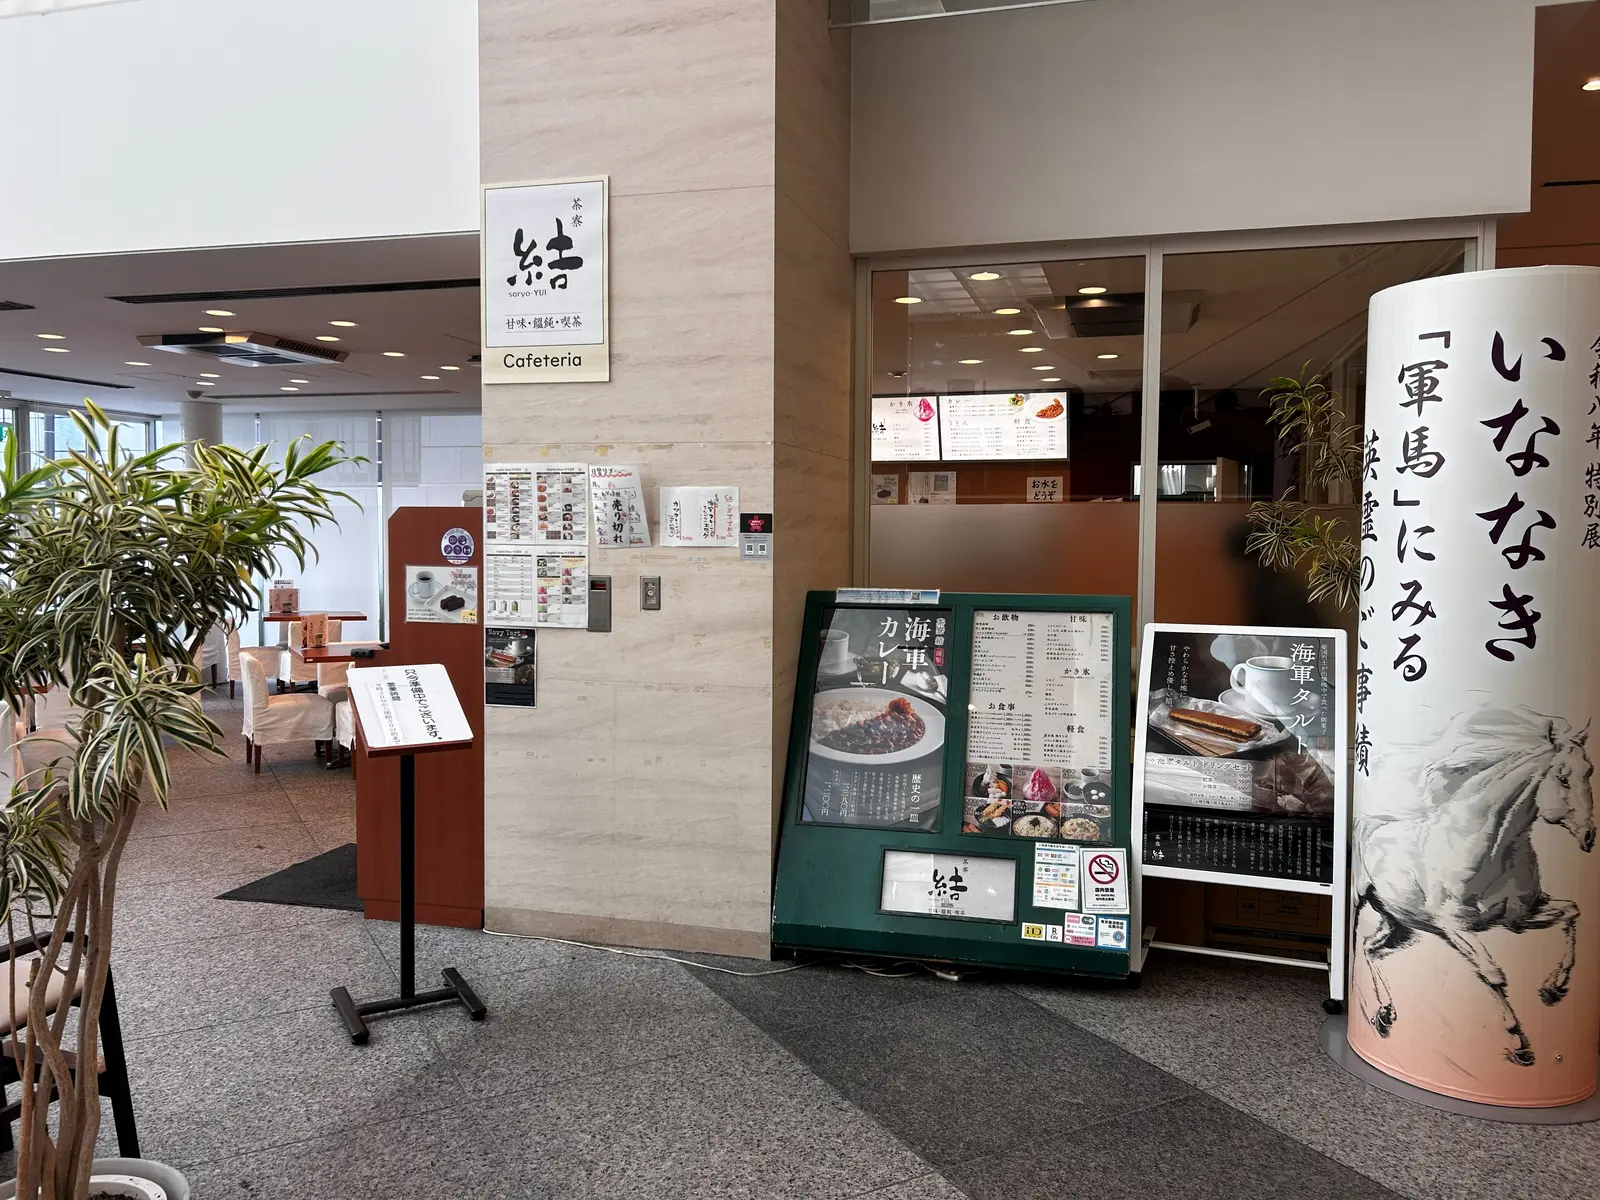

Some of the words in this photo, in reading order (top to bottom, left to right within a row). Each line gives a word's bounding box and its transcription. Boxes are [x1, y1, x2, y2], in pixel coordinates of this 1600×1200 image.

[571, 197, 583, 228] 茶寮
[507, 217, 583, 290] 結
[503, 352, 582, 368] Cafeteria
[1031, 479, 1058, 489] お水を
[1033, 490, 1057, 501] どうぞ
[1475, 330, 1566, 661] いななき
[612, 499, 624, 543] 売り切れ
[1392, 330, 1451, 682] 「軍馬」にみる
[993, 613, 1019, 622] お飲物
[1070, 615, 1087, 623] 甘味
[877, 615, 899, 685] カレー
[902, 616, 932, 670] 海軍
[1063, 667, 1090, 675] かき氷
[988, 702, 1016, 711] お食事
[1289, 643, 1316, 756] 海軍タルト
[1066, 724, 1085, 734] 軽食
[909, 773, 922, 822] 歴史の一皿
[928, 866, 968, 901] 結
[1026, 926, 1042, 937] iD
